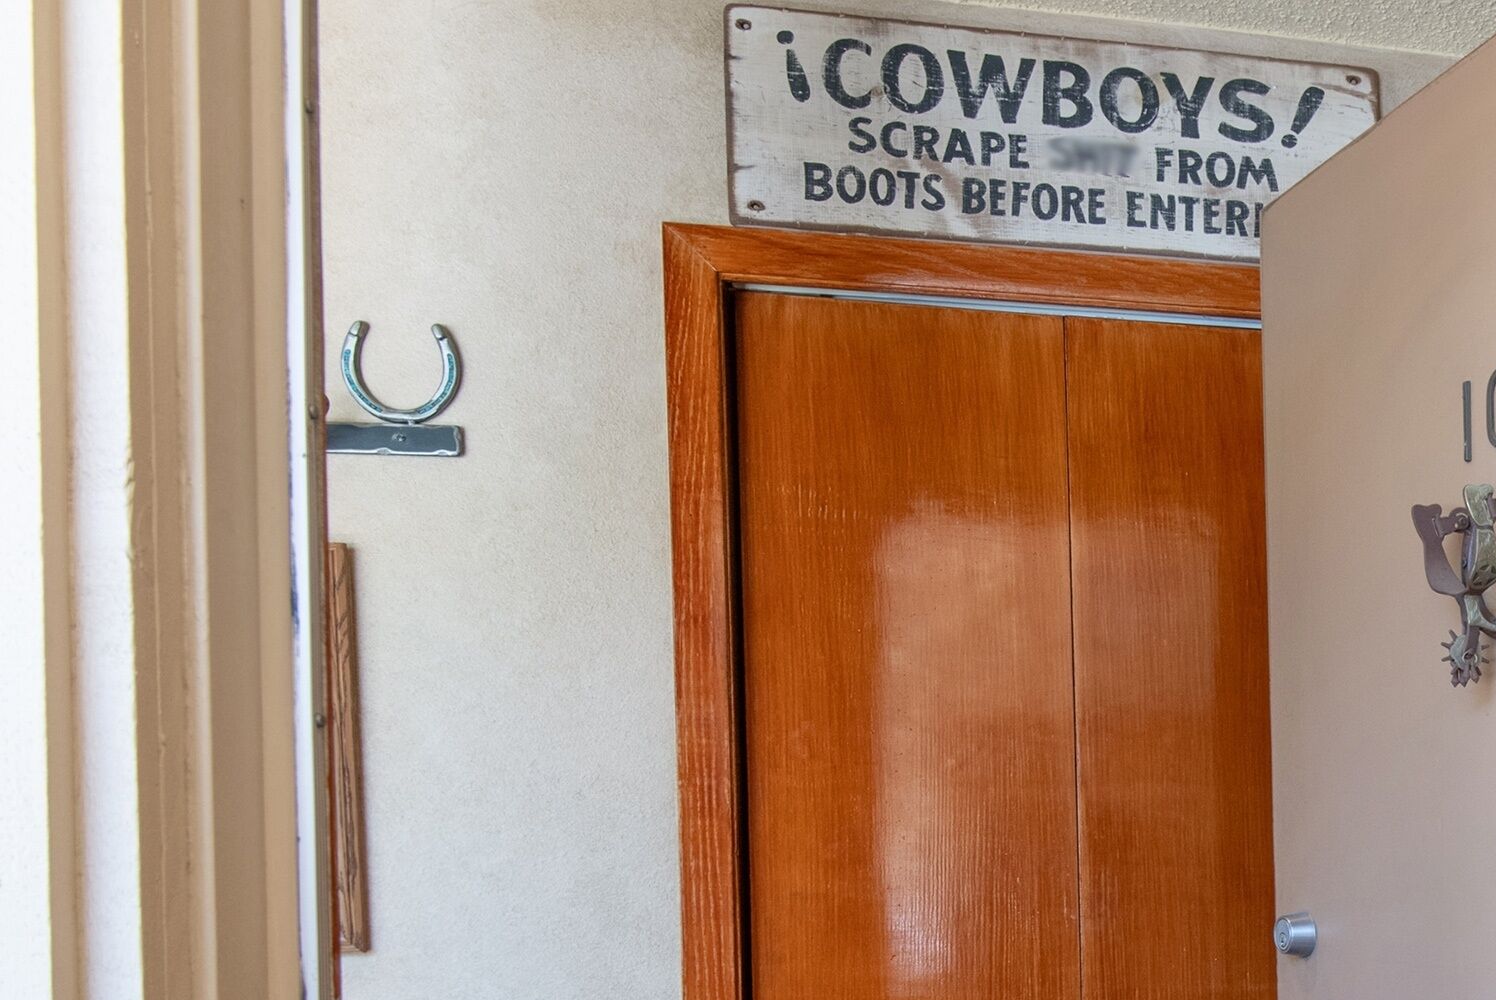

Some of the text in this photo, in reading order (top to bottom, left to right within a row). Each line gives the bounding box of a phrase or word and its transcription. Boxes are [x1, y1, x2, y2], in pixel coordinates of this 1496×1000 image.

[776, 30, 1325, 148] ¡COWBOYS!
[848, 116, 1029, 168] SCRAPE
[1155, 147, 1279, 192] FROM
[803, 161, 946, 211] BOOTS
[962, 177, 1106, 225] BEFORE
